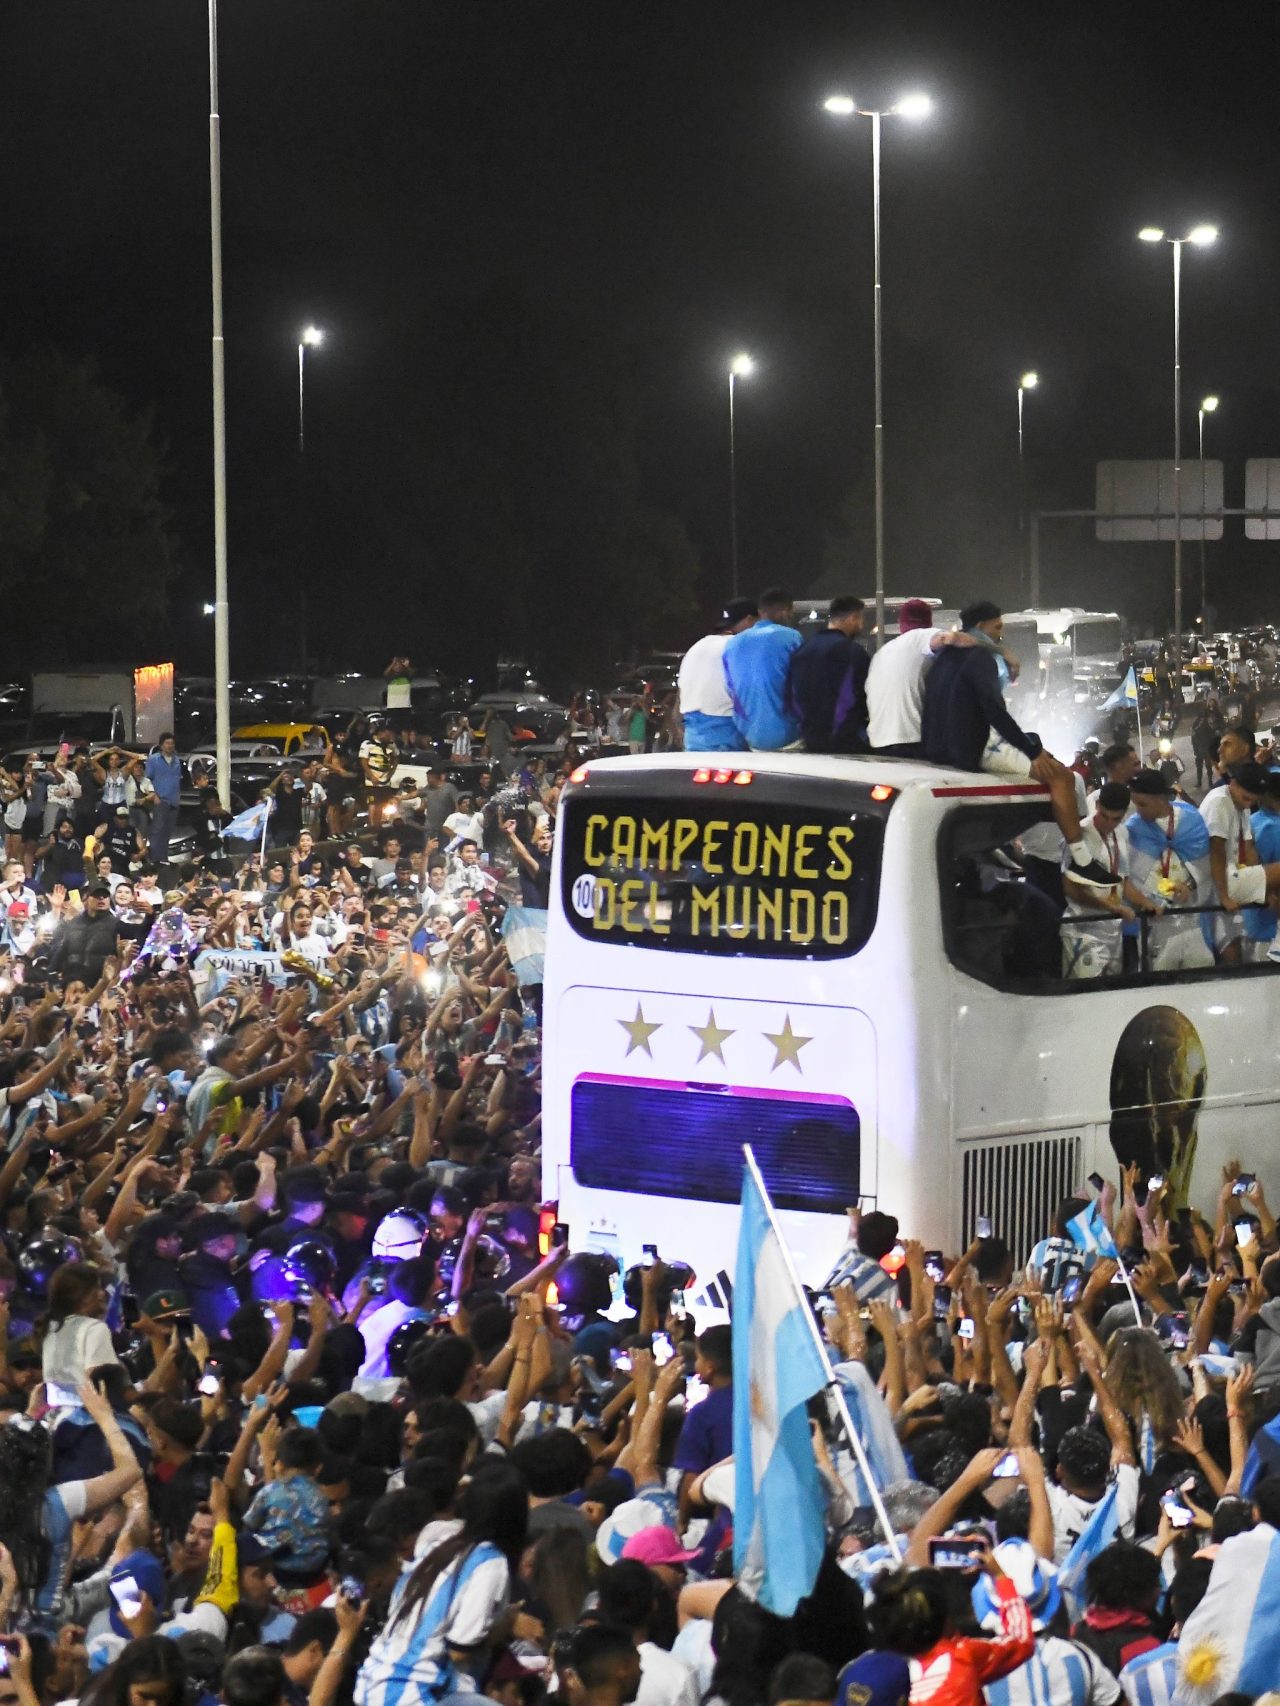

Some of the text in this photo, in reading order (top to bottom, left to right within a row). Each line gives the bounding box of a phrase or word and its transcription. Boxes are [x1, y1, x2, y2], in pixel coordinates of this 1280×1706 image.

[584, 814, 855, 881] CAMPEONES
[592, 877, 849, 945] DEL MUNDO
